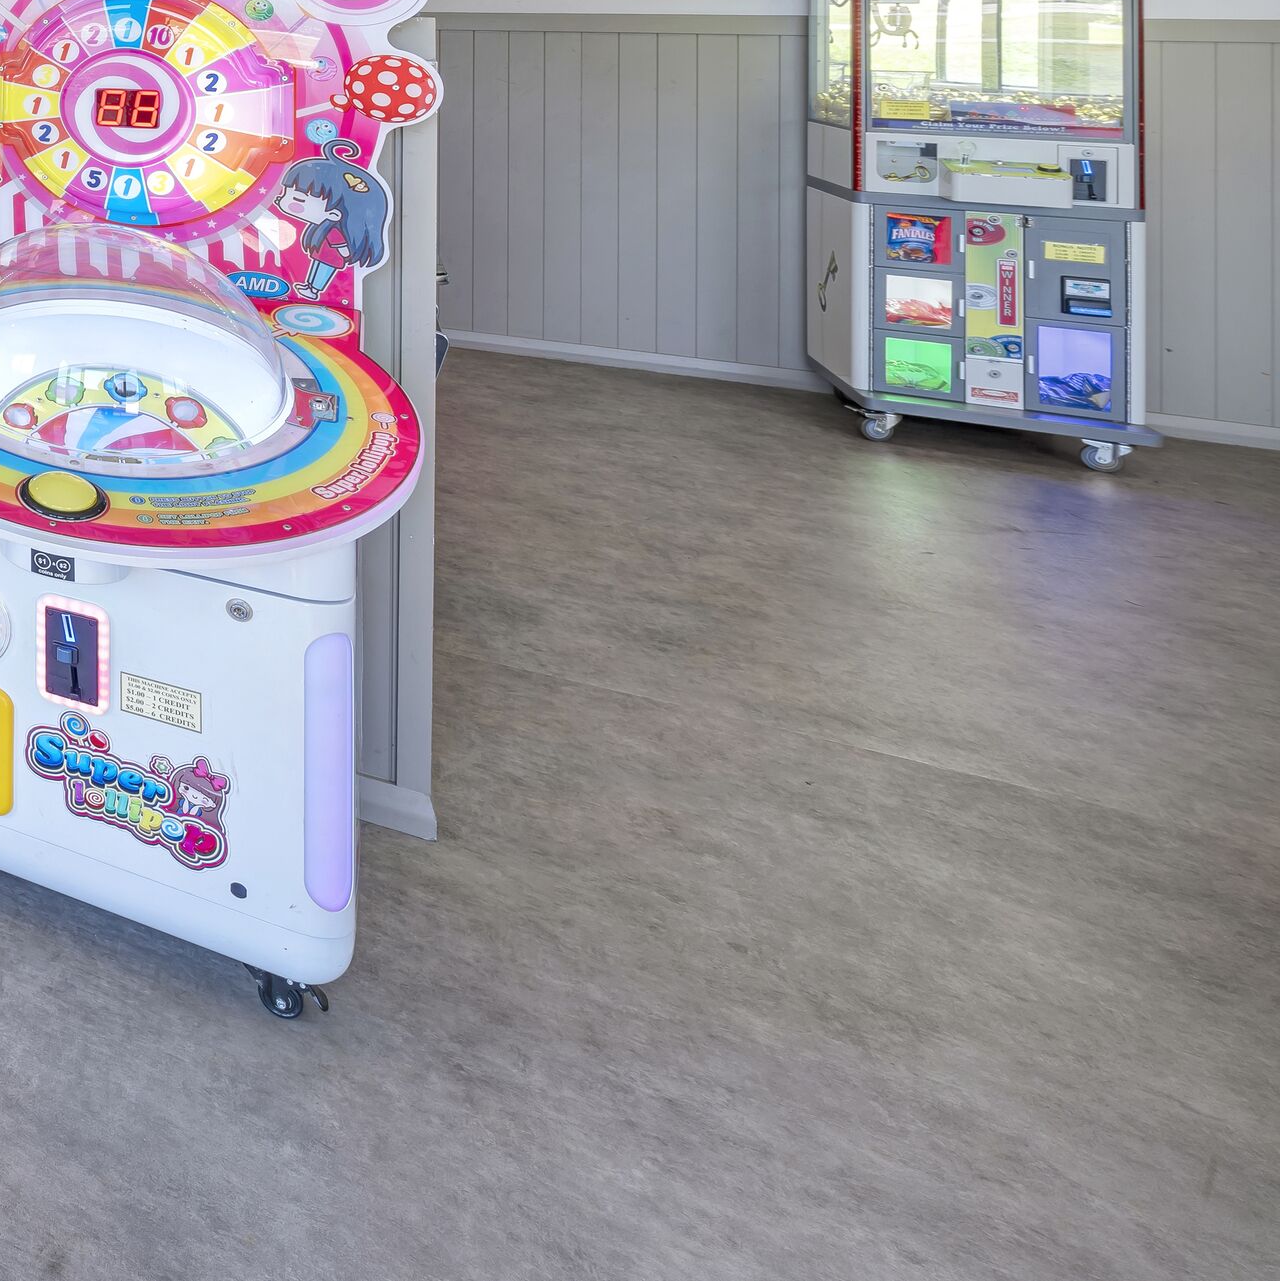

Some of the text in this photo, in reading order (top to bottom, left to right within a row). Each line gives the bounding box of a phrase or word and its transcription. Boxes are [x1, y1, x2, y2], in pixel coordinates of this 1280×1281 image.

[86, 28, 100, 47] 2
[124, 21, 133, 39] 1
[150, 27, 171, 45] 10
[59, 43, 71, 61] 1
[184, 47, 194, 65] 1
[39, 67, 54, 84] 3
[205, 73, 219, 92] 2
[32, 97, 42, 114] 1
[214, 104, 224, 122] 1
[38, 124, 52, 142] 2
[920, 120, 954, 129] Claim
[958, 122, 985, 130] Your
[203, 133, 219, 151] 2
[60, 151, 71, 169] 1
[185, 159, 195, 177] 1
[87, 170, 102, 188] 5
[122, 178, 133, 195] 1
[153, 174, 169, 191] 3
[892, 228, 935, 241] FANTALES
[236, 276, 280, 293] AMD
[1001, 271, 1013, 317] WINNER
[350, 432, 397, 473] lollipop
[312, 470, 369, 499] Super
[38, 557, 46, 565] $1
[127, 676, 197, 699] THIS MACHINE ACCEPTS
[126, 688, 145, 698] $1.00
[158, 697, 191, 711] CREDIT
[161, 691, 180, 700] COINS
[180, 697, 197, 705] ONLY
[125, 703, 144, 714] $5.00
[159, 713, 196, 729] CREDITS
[126, 695, 144, 706] $2.00
[158, 704, 195, 720] CREDITS
[34, 734, 166, 801] Super
